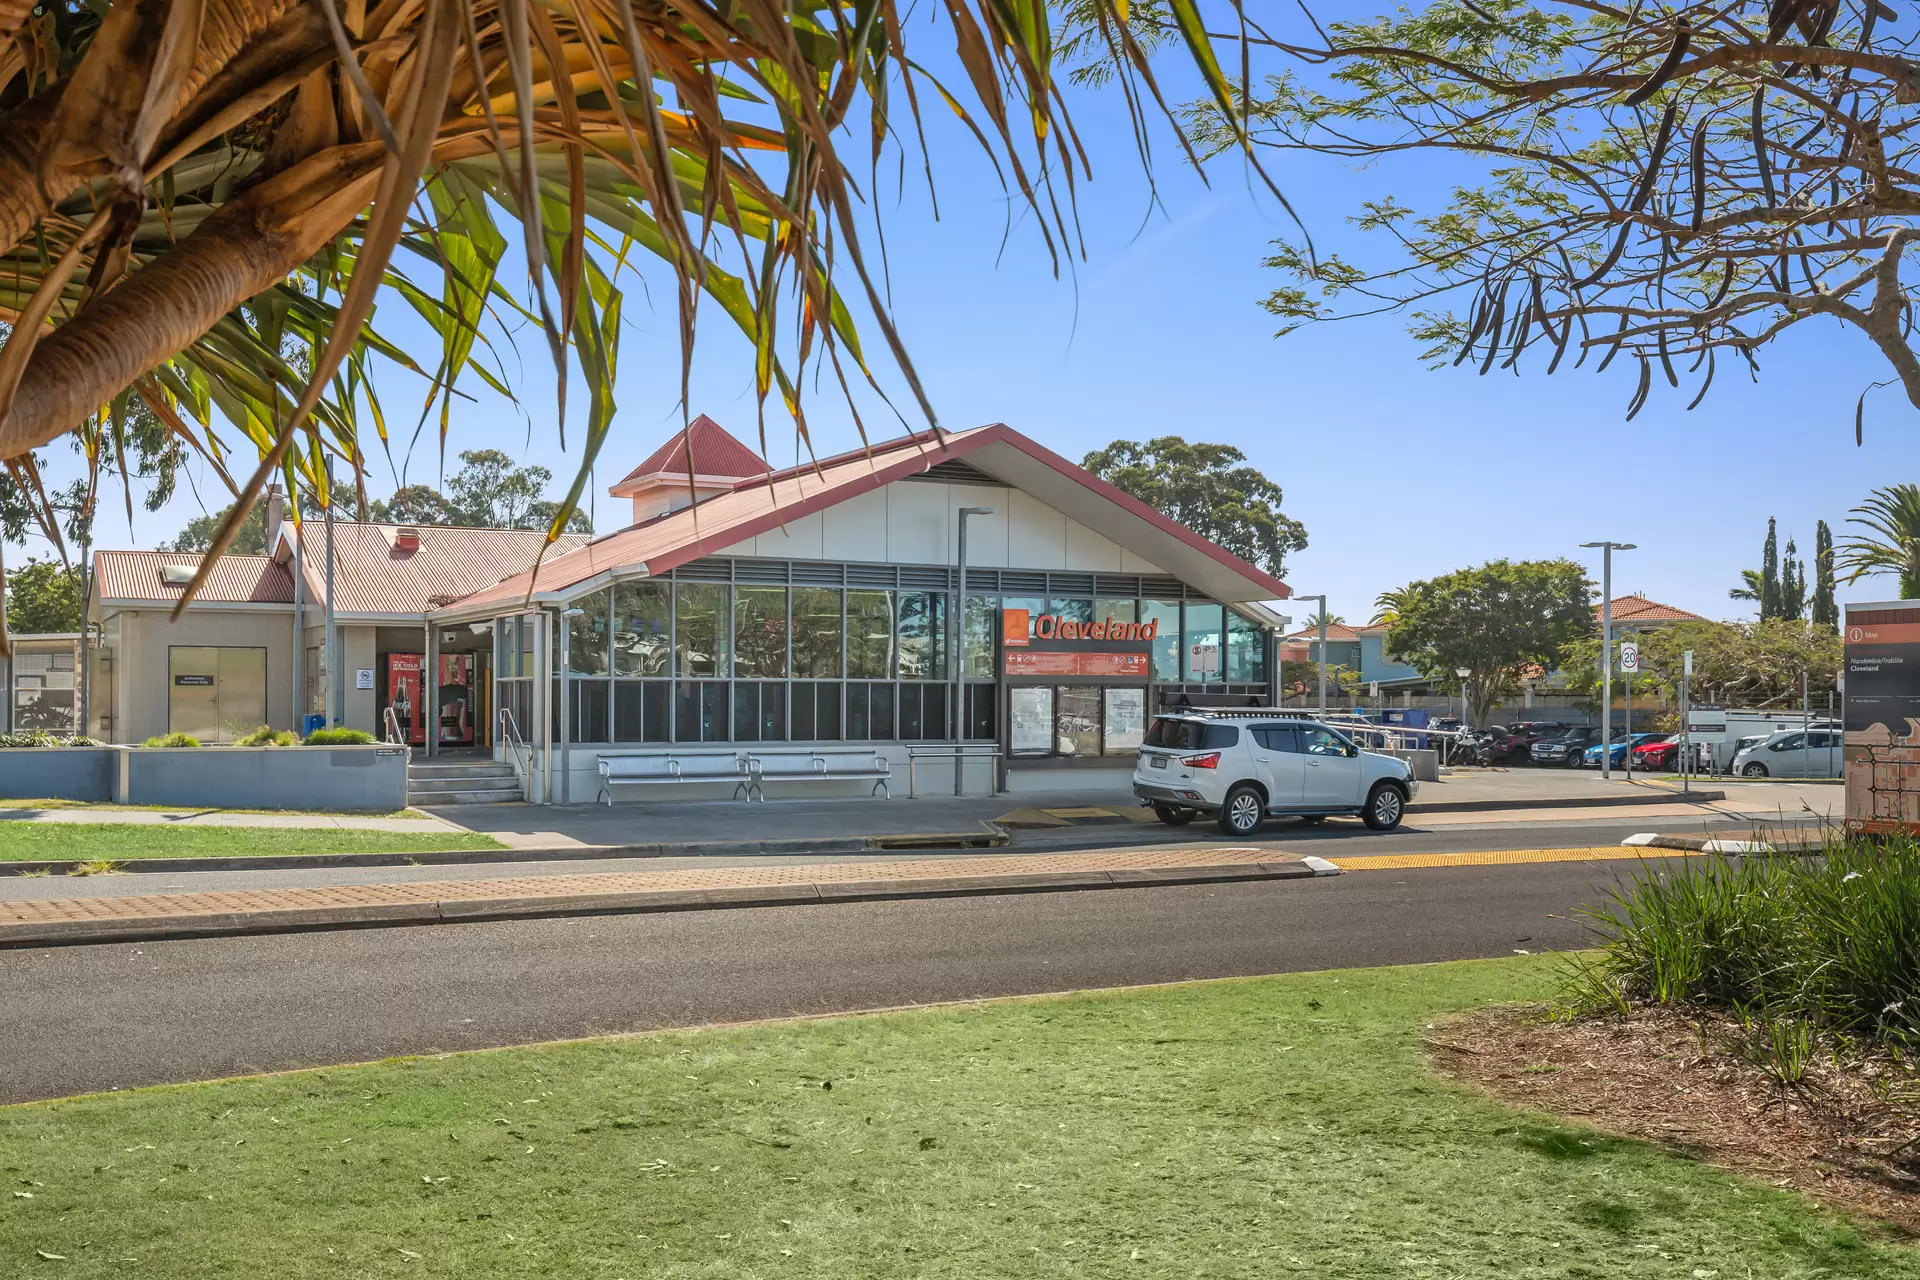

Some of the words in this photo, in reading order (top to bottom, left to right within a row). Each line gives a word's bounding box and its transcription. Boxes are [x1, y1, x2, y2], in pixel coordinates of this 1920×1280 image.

[1035, 614, 1159, 641] Cleveland
[1864, 631, 1879, 639] Map
[1624, 652, 1635, 663] 20
